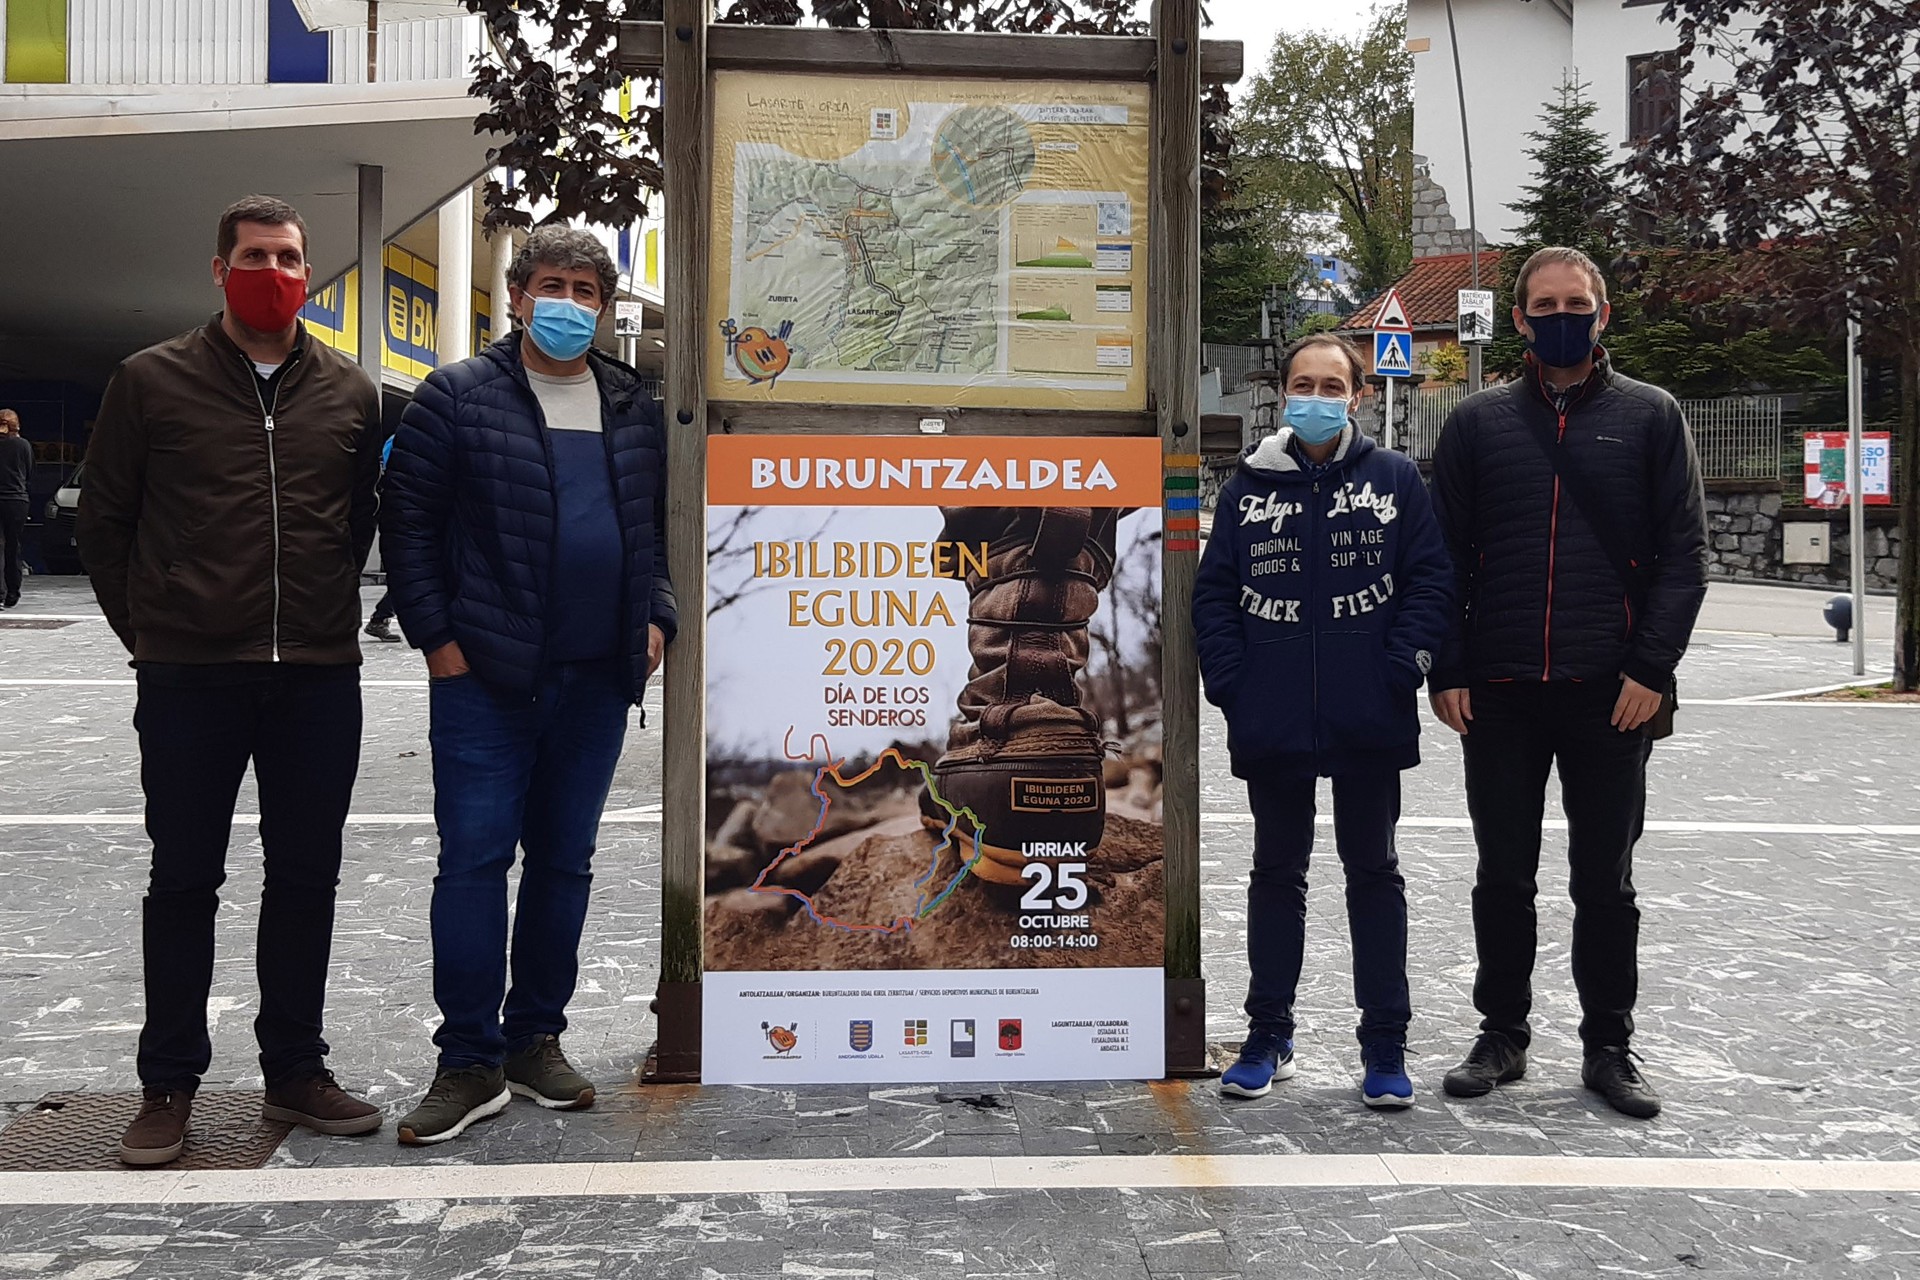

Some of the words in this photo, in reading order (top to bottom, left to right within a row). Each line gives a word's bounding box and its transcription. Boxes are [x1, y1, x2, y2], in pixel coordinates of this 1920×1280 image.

[768, 295, 798, 303] ZUBIETA
[751, 458, 1118, 490] BURUNTZALDEA
[1250, 537, 1302, 557] ORIGINAL
[1330, 528, 1385, 547] VINAGE
[753, 541, 989, 578] IBILBIDEEN
[1251, 559, 1287, 577] GOODS
[1291, 557, 1301, 572] &
[1330, 550, 1382, 568] SUPLY
[788, 590, 956, 627] EGUNA
[1239, 584, 1301, 622] TRACK
[1331, 573, 1394, 618] FIELD
[821, 638, 936, 676] 2020
[824, 681, 858, 704] DÍA
[863, 687, 888, 704] DE
[892, 687, 930, 704] LOS
[827, 709, 926, 727] SENDEROS
[1023, 795, 1061, 806] EGUNA
[1064, 795, 1091, 805] 2020
[1025, 784, 1084, 794] IBILBIDEEN
[1021, 841, 1087, 857] URRIAK
[1020, 862, 1088, 910] 25
[1018, 915, 1090, 929] OCTUBRE
[1010, 934, 1098, 948] 08:00-14:00
